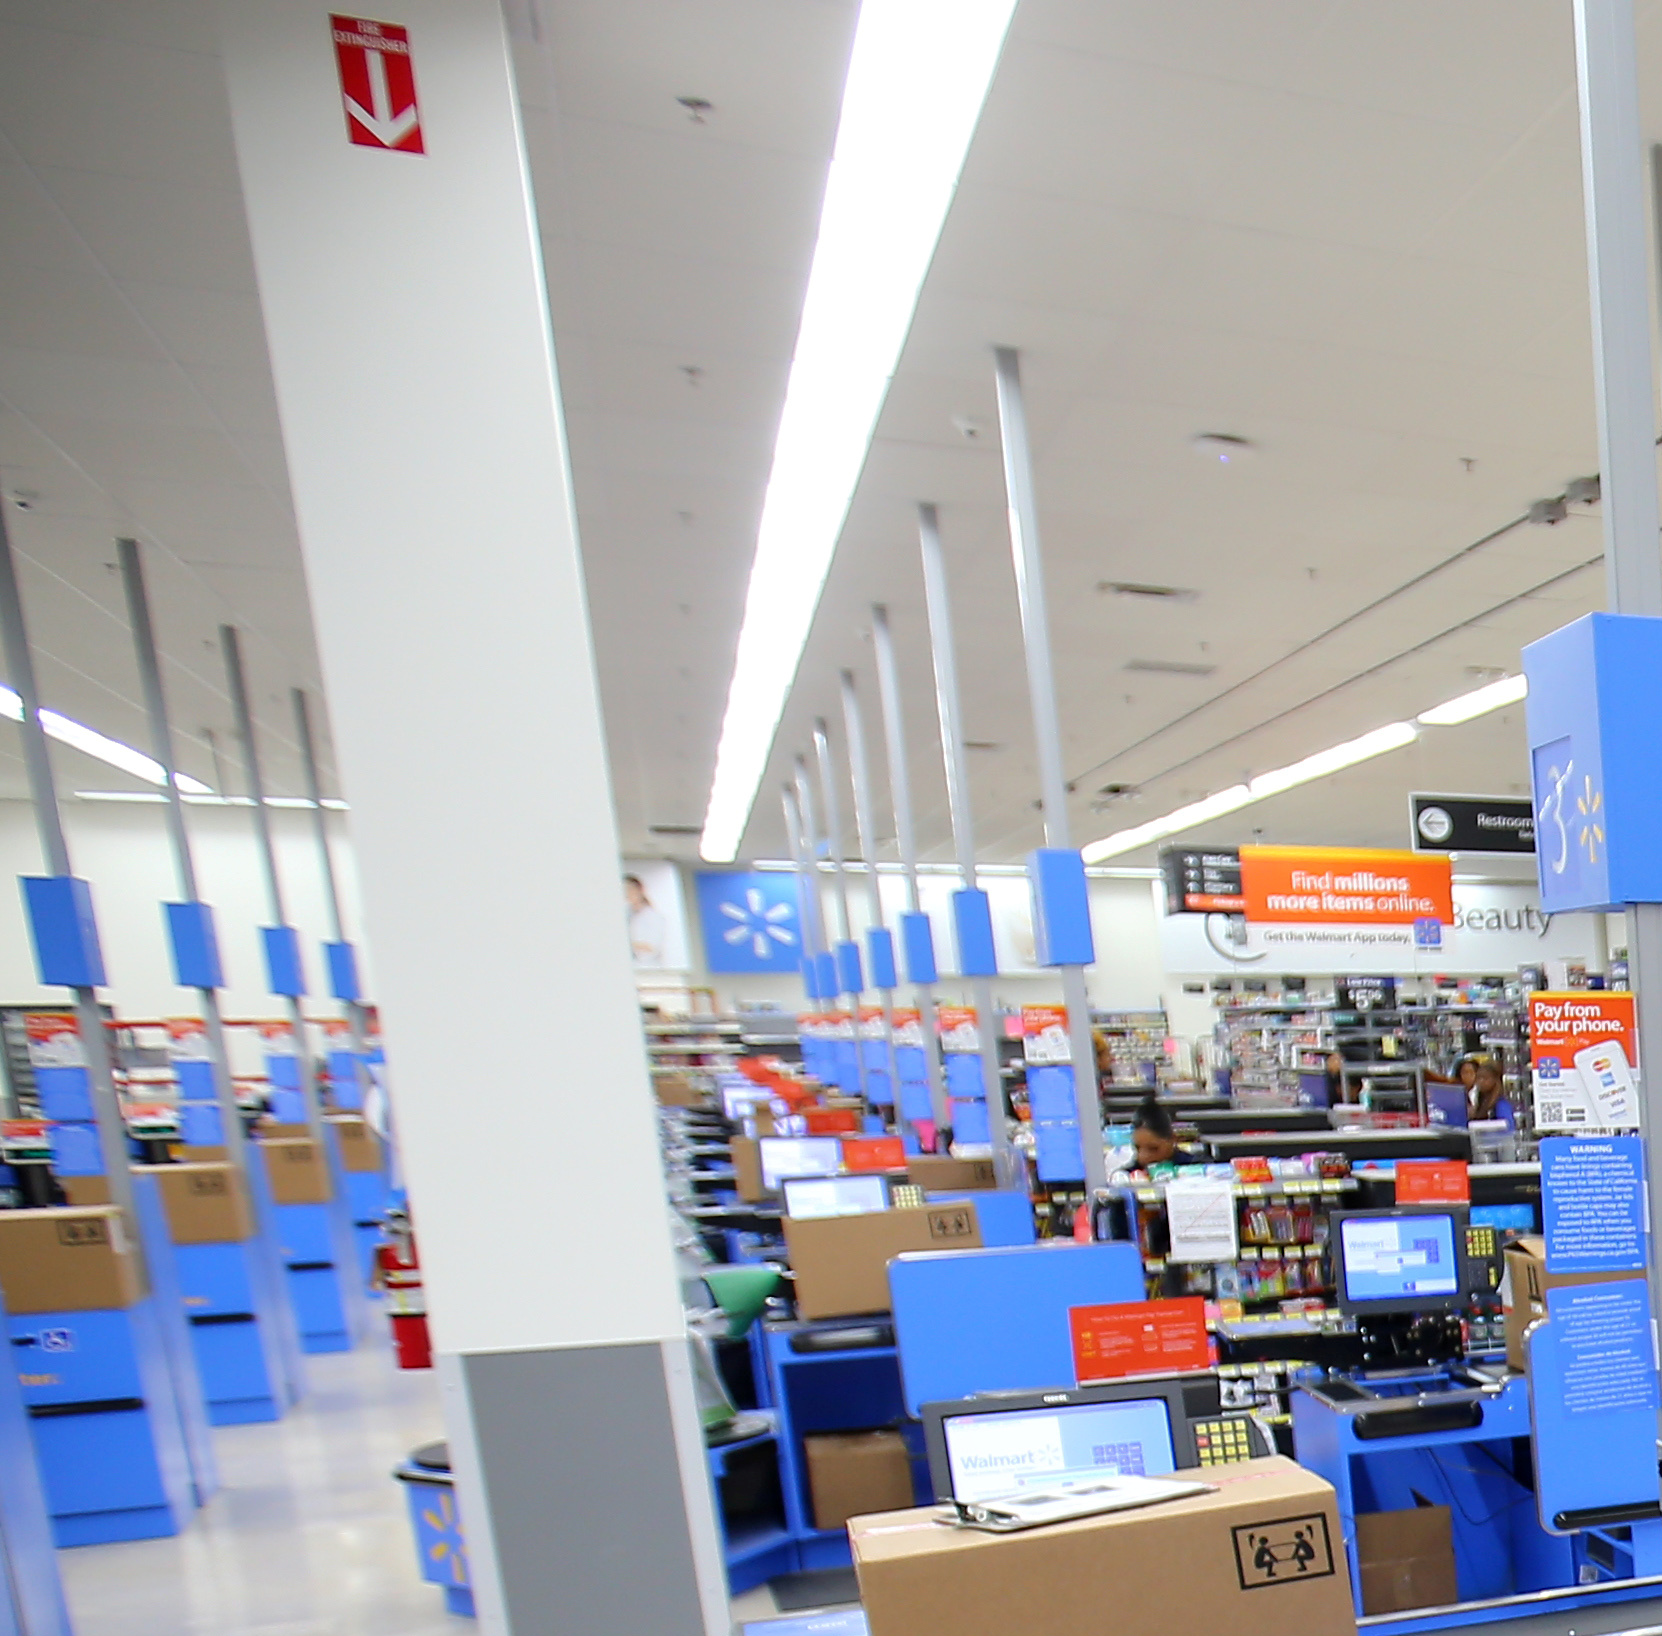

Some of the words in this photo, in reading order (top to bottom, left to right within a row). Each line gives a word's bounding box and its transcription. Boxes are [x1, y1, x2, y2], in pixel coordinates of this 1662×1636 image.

[357, 20, 382, 35] FIRE
[334, 30, 408, 52] EXTINGUISHER
[1477, 813, 1534, 829] Restroom
[1291, 871, 1331, 891] Find
[1334, 873, 1409, 892] millions
[1267, 895, 1319, 910] more
[1321, 893, 1373, 912] items
[1377, 894, 1435, 913] online.
[1453, 902, 1553, 937] Beauty
[1264, 930, 1284, 941] Get
[1287, 930, 1303, 941] the
[1305, 930, 1352, 943] Walmart
[1355, 932, 1376, 944] App
[1378, 932, 1411, 945] today.
[1535, 1003, 1561, 1021] Pay
[1564, 1003, 1600, 1018] from
[1536, 1020, 1570, 1036] your
[1574, 1018, 1624, 1035] phone.
[1569, 1145, 1612, 1155] WARNING
